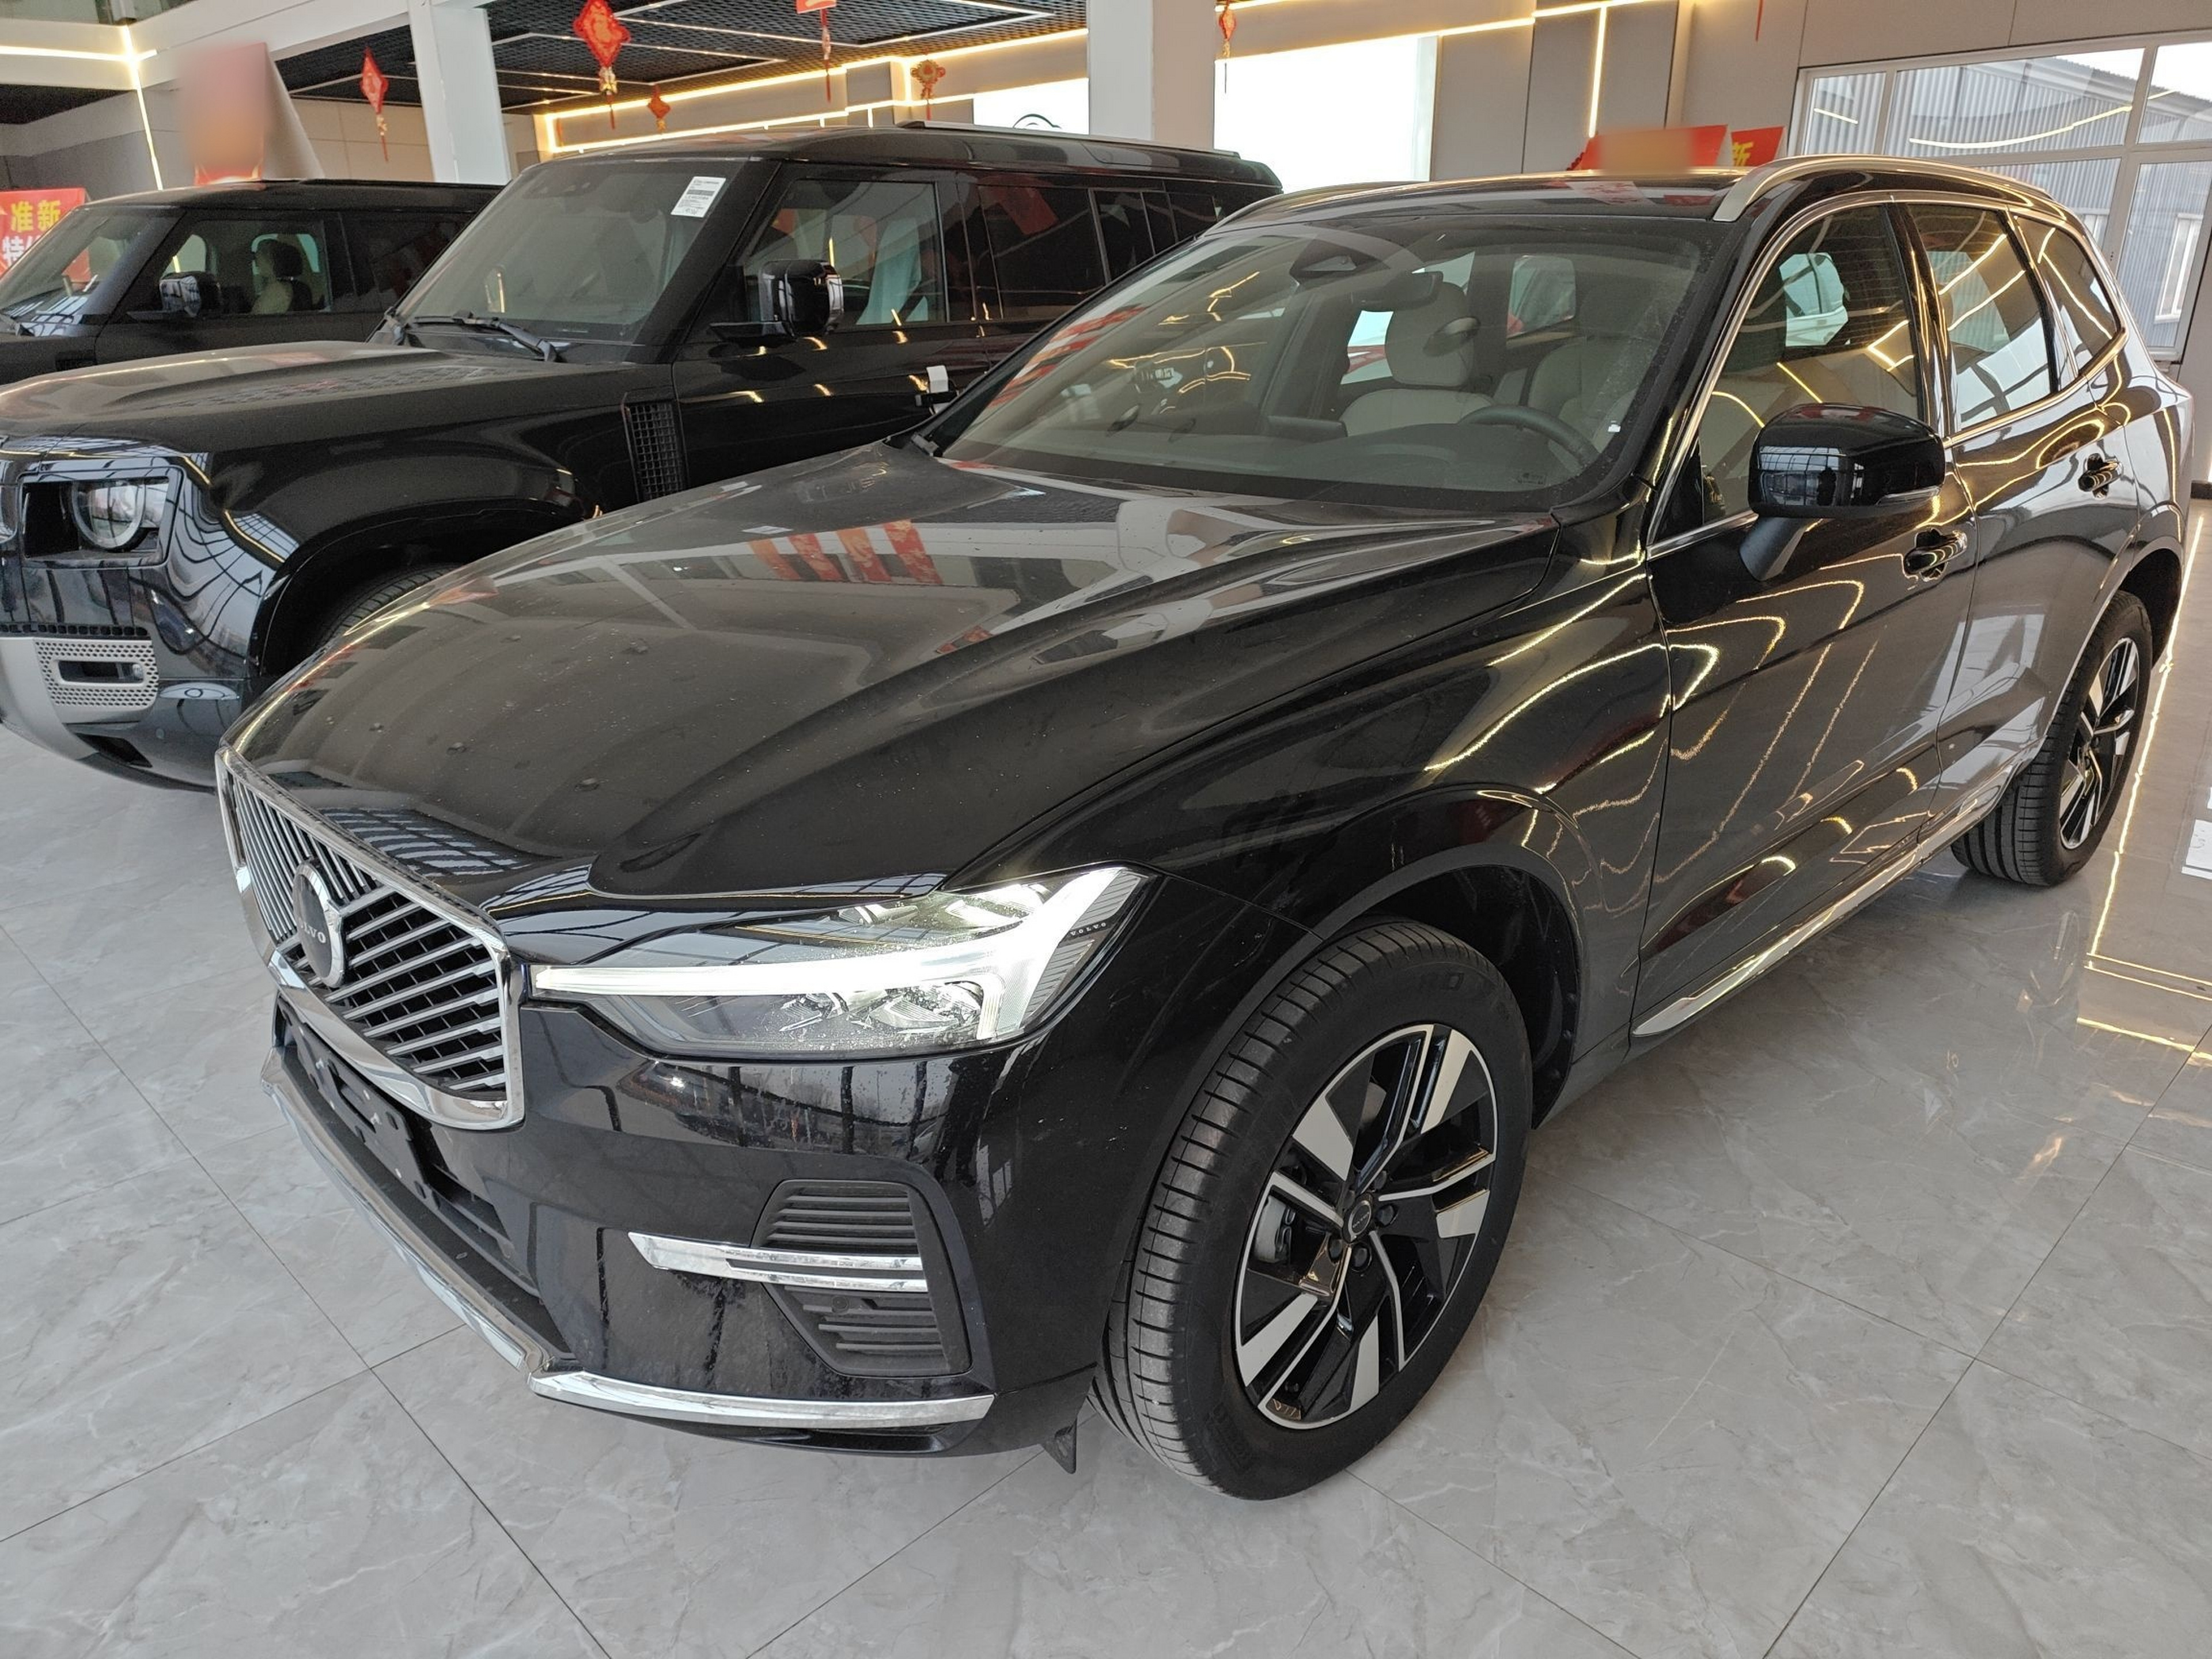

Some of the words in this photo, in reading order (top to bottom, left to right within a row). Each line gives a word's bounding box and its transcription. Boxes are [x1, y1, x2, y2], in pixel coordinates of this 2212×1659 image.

[11, 200, 61, 233] 准新
[300, 919, 327, 944] LVO
[1070, 922, 1106, 935] VOLVO
